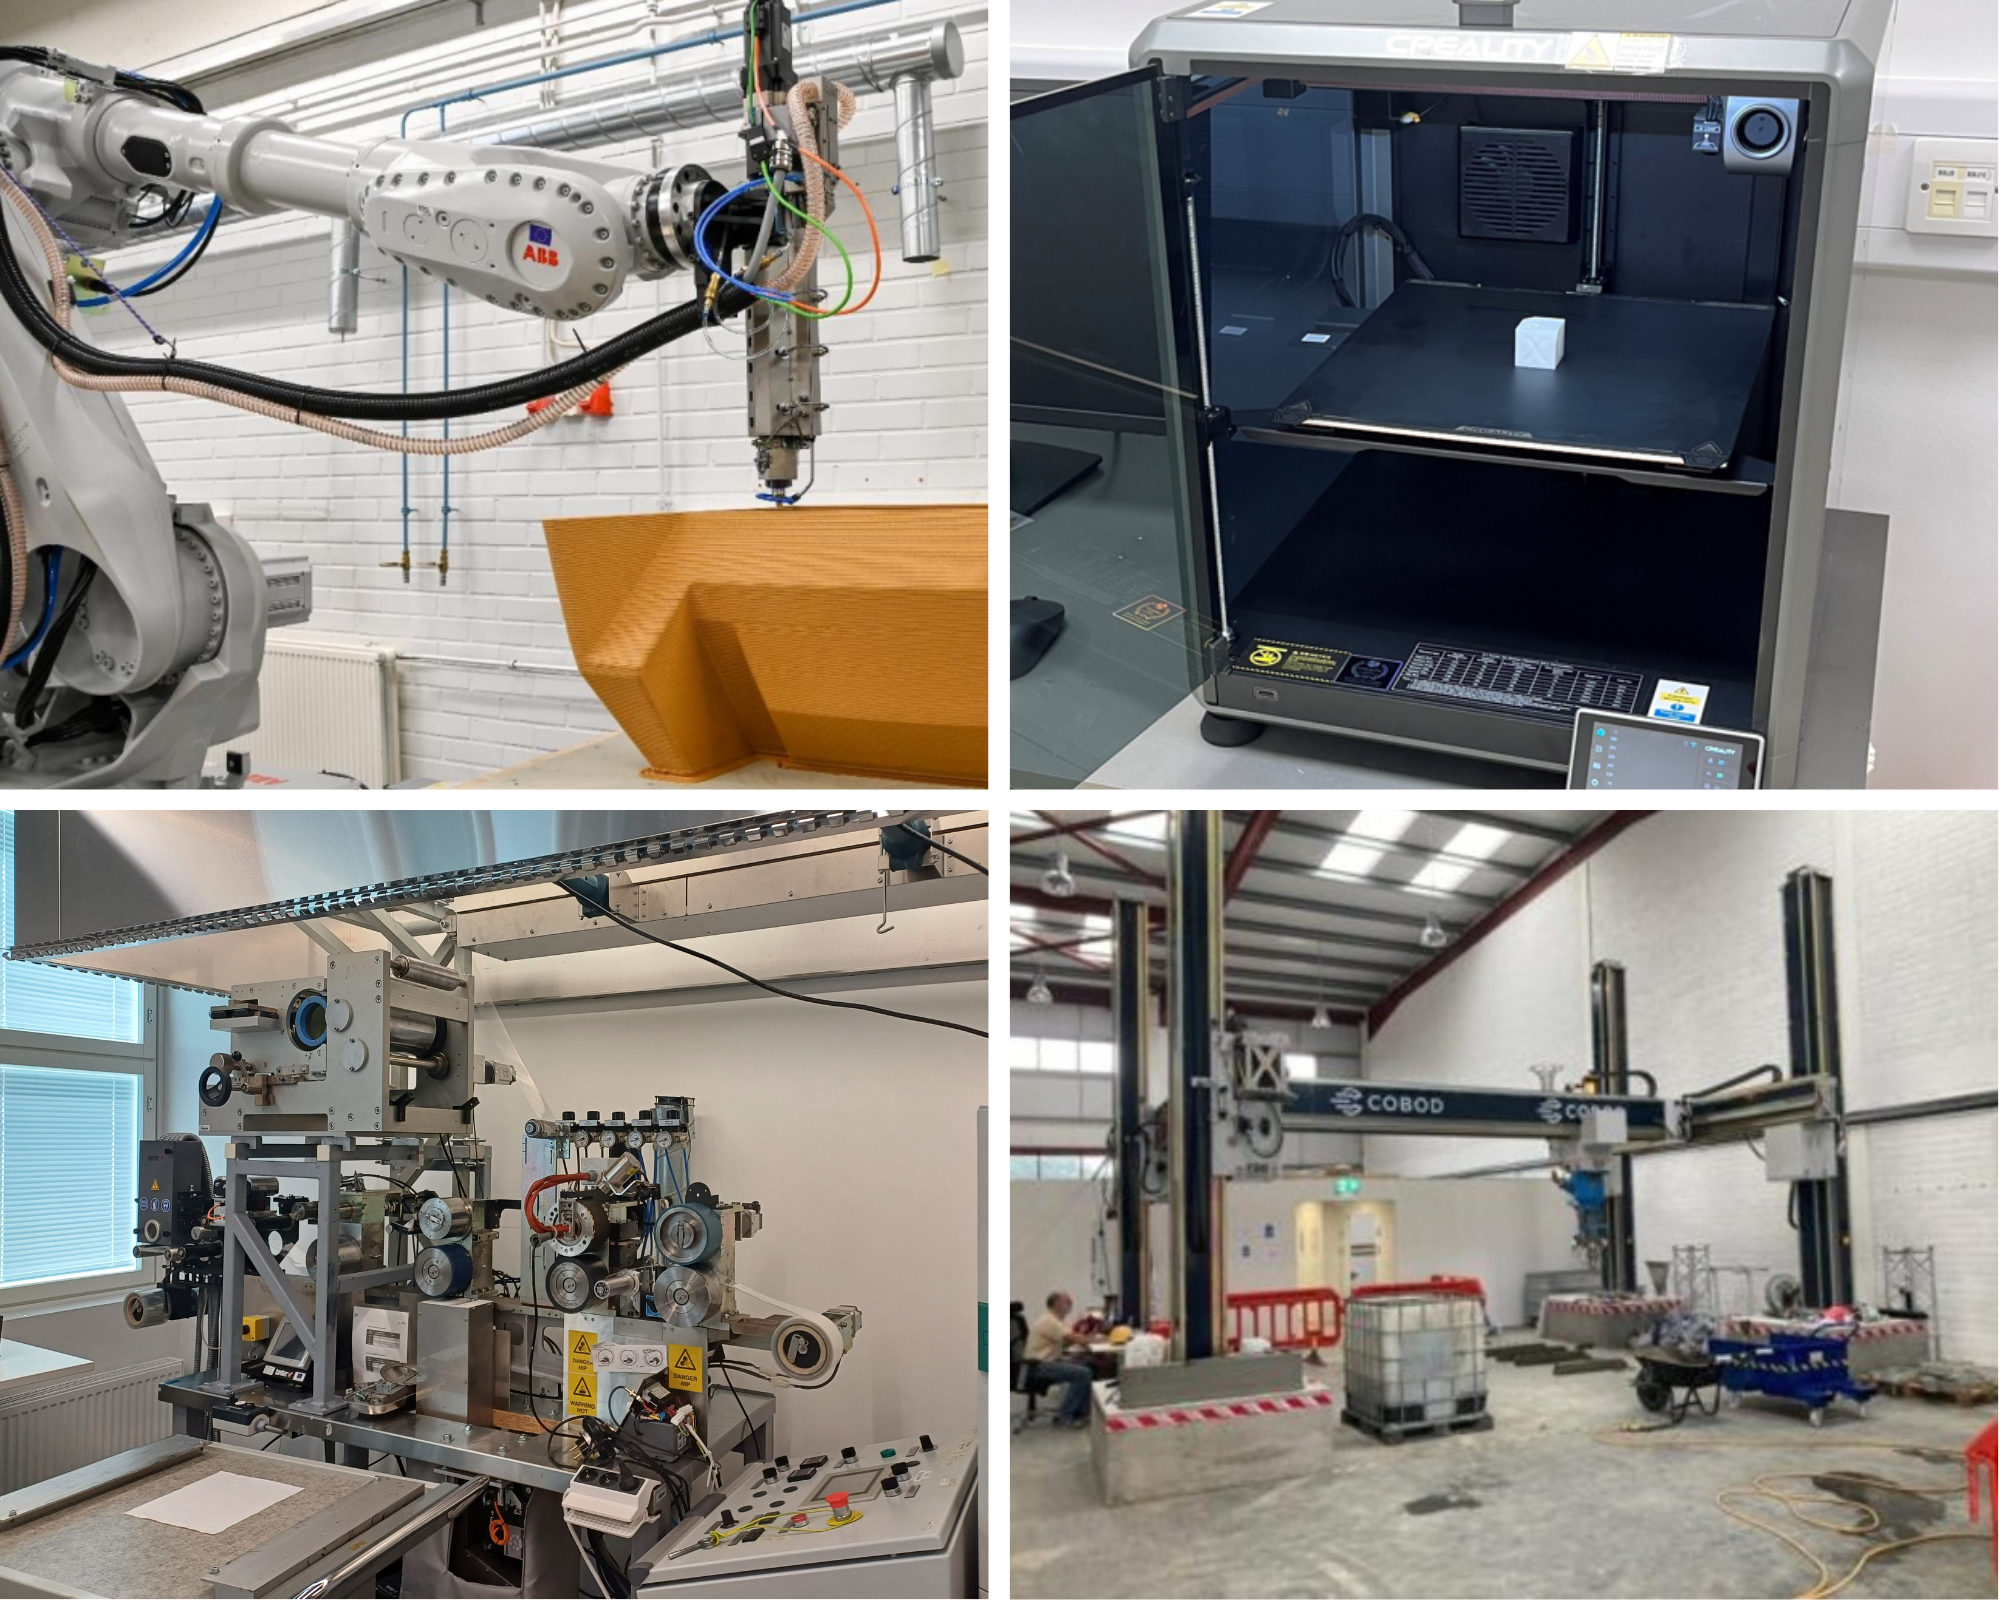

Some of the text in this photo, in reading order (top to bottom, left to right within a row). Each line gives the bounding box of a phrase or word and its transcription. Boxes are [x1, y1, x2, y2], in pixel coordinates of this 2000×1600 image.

[523, 244, 559, 267] ABB
[1367, 1095, 1444, 1113] COBOD
[673, 1373, 698, 1382] DANGER
[570, 1400, 596, 1410] WARNING
